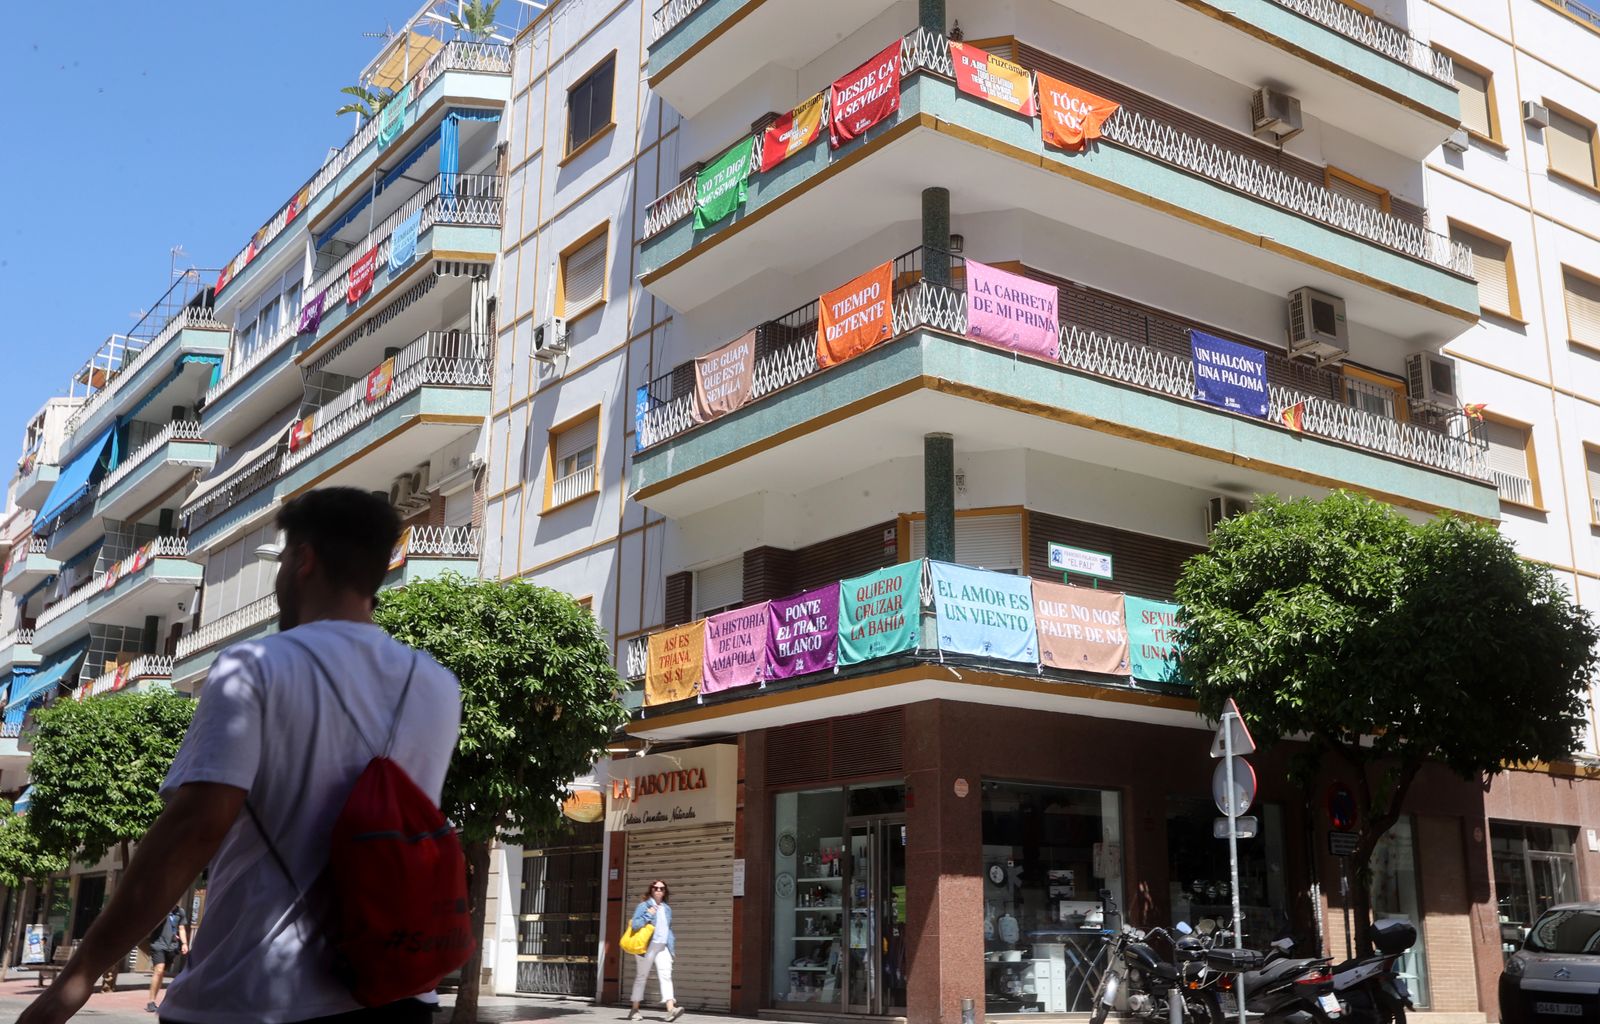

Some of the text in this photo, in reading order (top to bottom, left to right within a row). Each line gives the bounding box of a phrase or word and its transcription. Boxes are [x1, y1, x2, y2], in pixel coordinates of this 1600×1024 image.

[987, 53, 1030, 79] Cruzcampo
[835, 76, 892, 122] A SEVILLA
[837, 70, 876, 106] DESDE
[702, 179, 713, 194] YO
[714, 169, 725, 186] TE
[832, 282, 880, 319] TIEMPO
[974, 278, 1053, 315] LA CARRETA
[826, 299, 886, 341] DETENTE
[973, 295, 1055, 333] DE MI PRIMA
[702, 343, 749, 377] QUE GUAPA
[704, 357, 745, 390] QUE ESTÁ
[1195, 347, 1263, 376] UN HALCÓN Y
[707, 376, 740, 402] SEVILLA
[1198, 363, 1264, 393] UNA PALOMA
[856, 575, 903, 602] QUIERO
[937, 579, 1030, 611] EL AMOR ES
[785, 599, 821, 622] PONTE
[855, 594, 903, 622] CRUZAR
[943, 603, 1028, 632] UN VIENTO
[1039, 599, 1120, 626] QUE NO NOS
[709, 611, 765, 640] LA HISTORIA
[776, 615, 828, 641] EL TRAJE
[851, 611, 905, 641] LA BAHÍA
[1040, 619, 1126, 645] FALTE DE NÁ
[664, 633, 690, 653] ASÍ ES
[719, 632, 752, 653] DE UNA
[778, 634, 822, 658] BLANCO
[1141, 644, 1168, 661] UNA
[712, 648, 756, 671] AMAPOLA
[612, 767, 708, 802] LA JABOTECA
